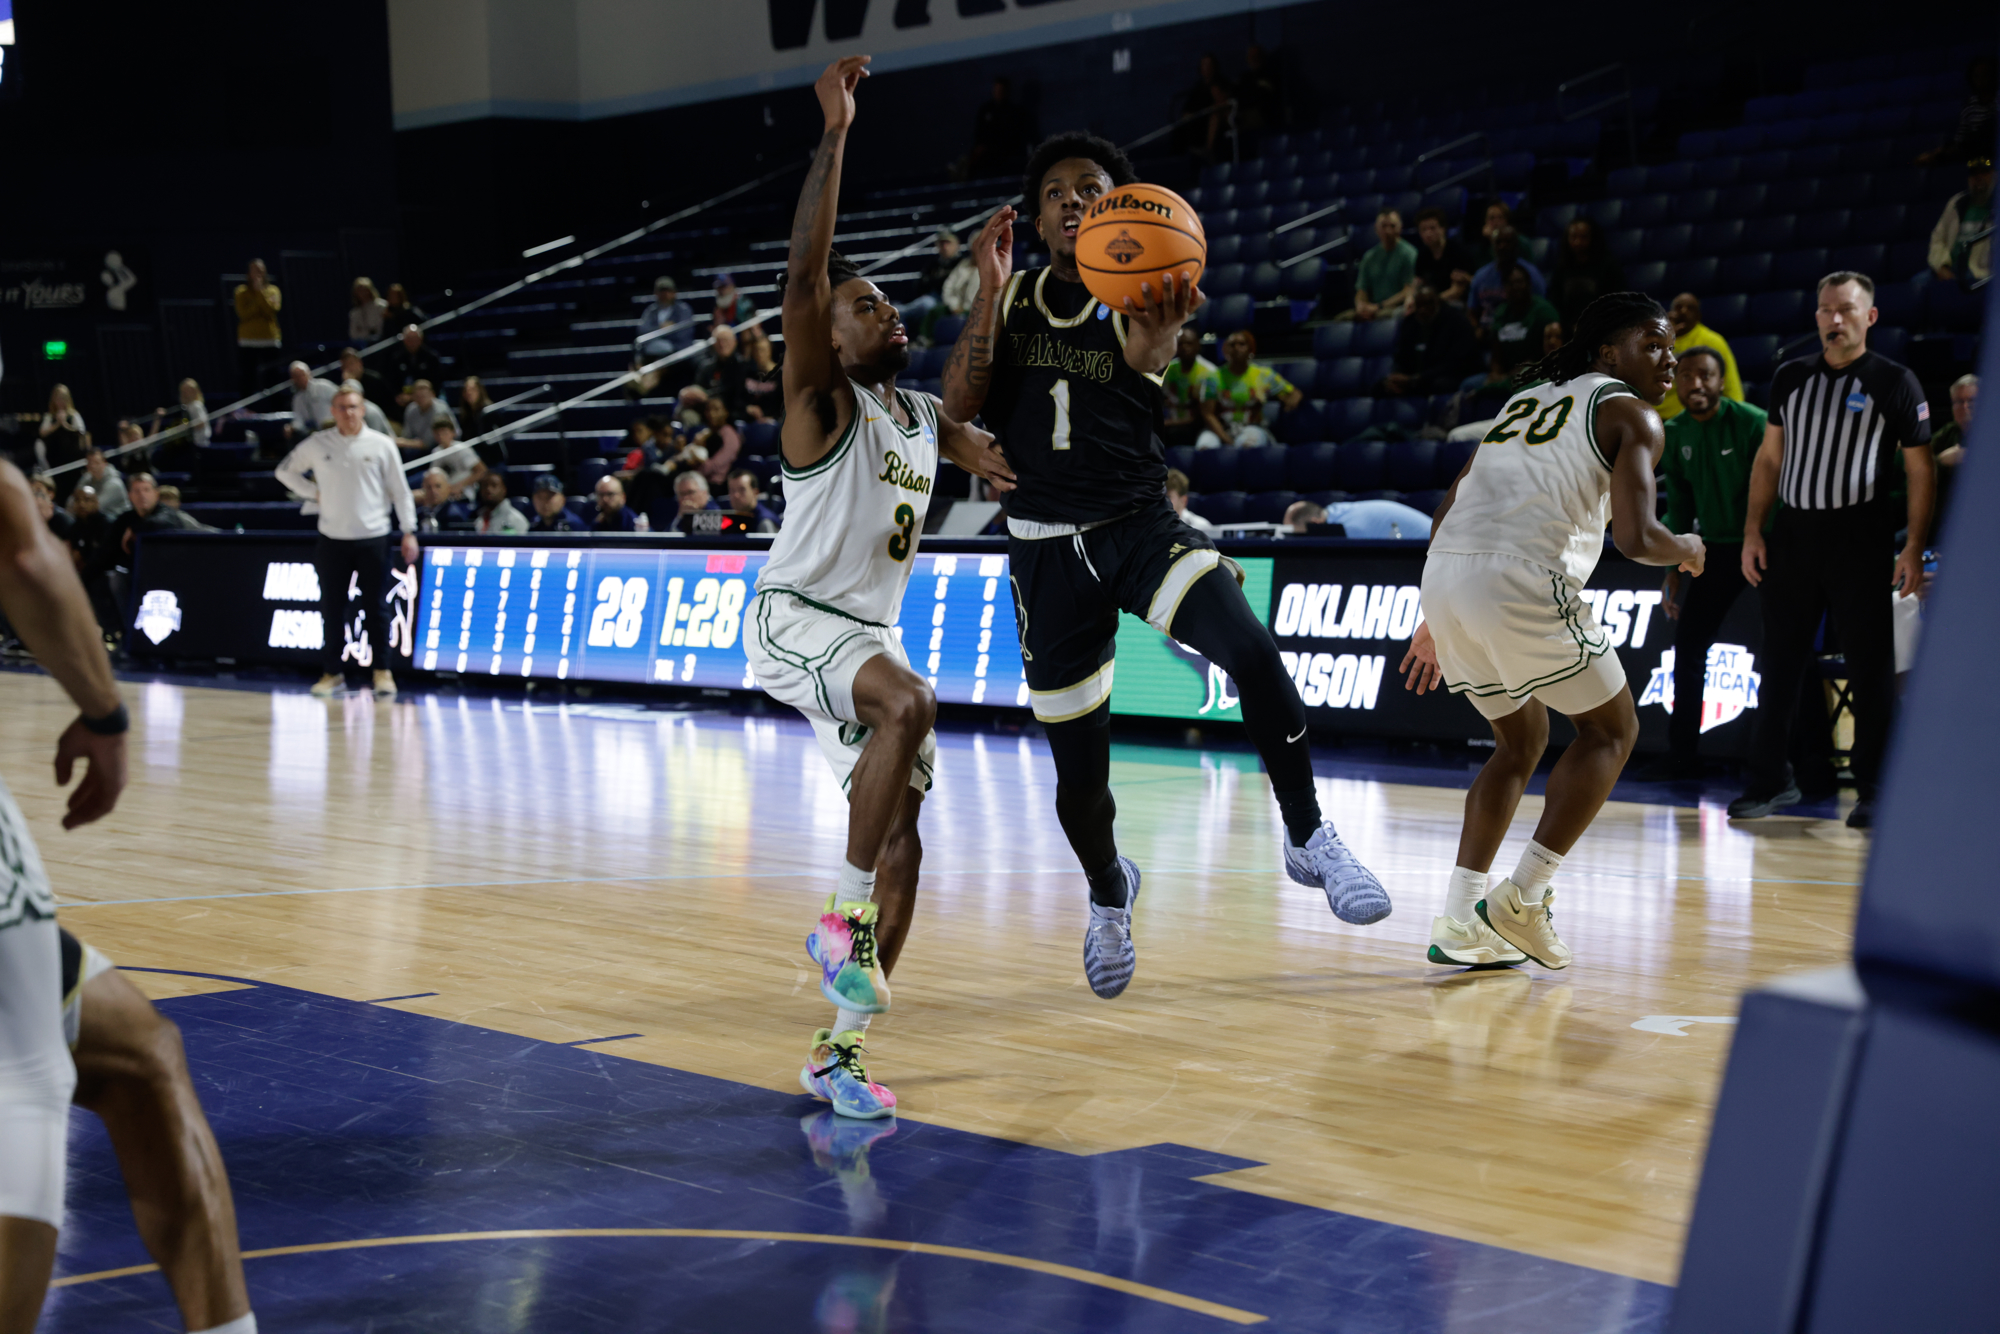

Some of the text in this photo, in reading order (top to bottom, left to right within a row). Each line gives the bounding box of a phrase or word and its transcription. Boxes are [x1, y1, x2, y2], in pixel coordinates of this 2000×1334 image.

[1090, 194, 1174, 219] Wilson
[1049, 378, 1071, 450] 1
[1482, 395, 1574, 445] 20
[879, 450, 931, 495] Bison
[888, 502, 915, 562] 3
[587, 576, 649, 648] 28
[659, 577, 747, 649] 1:28
[1706, 647, 1740, 669] EAT
